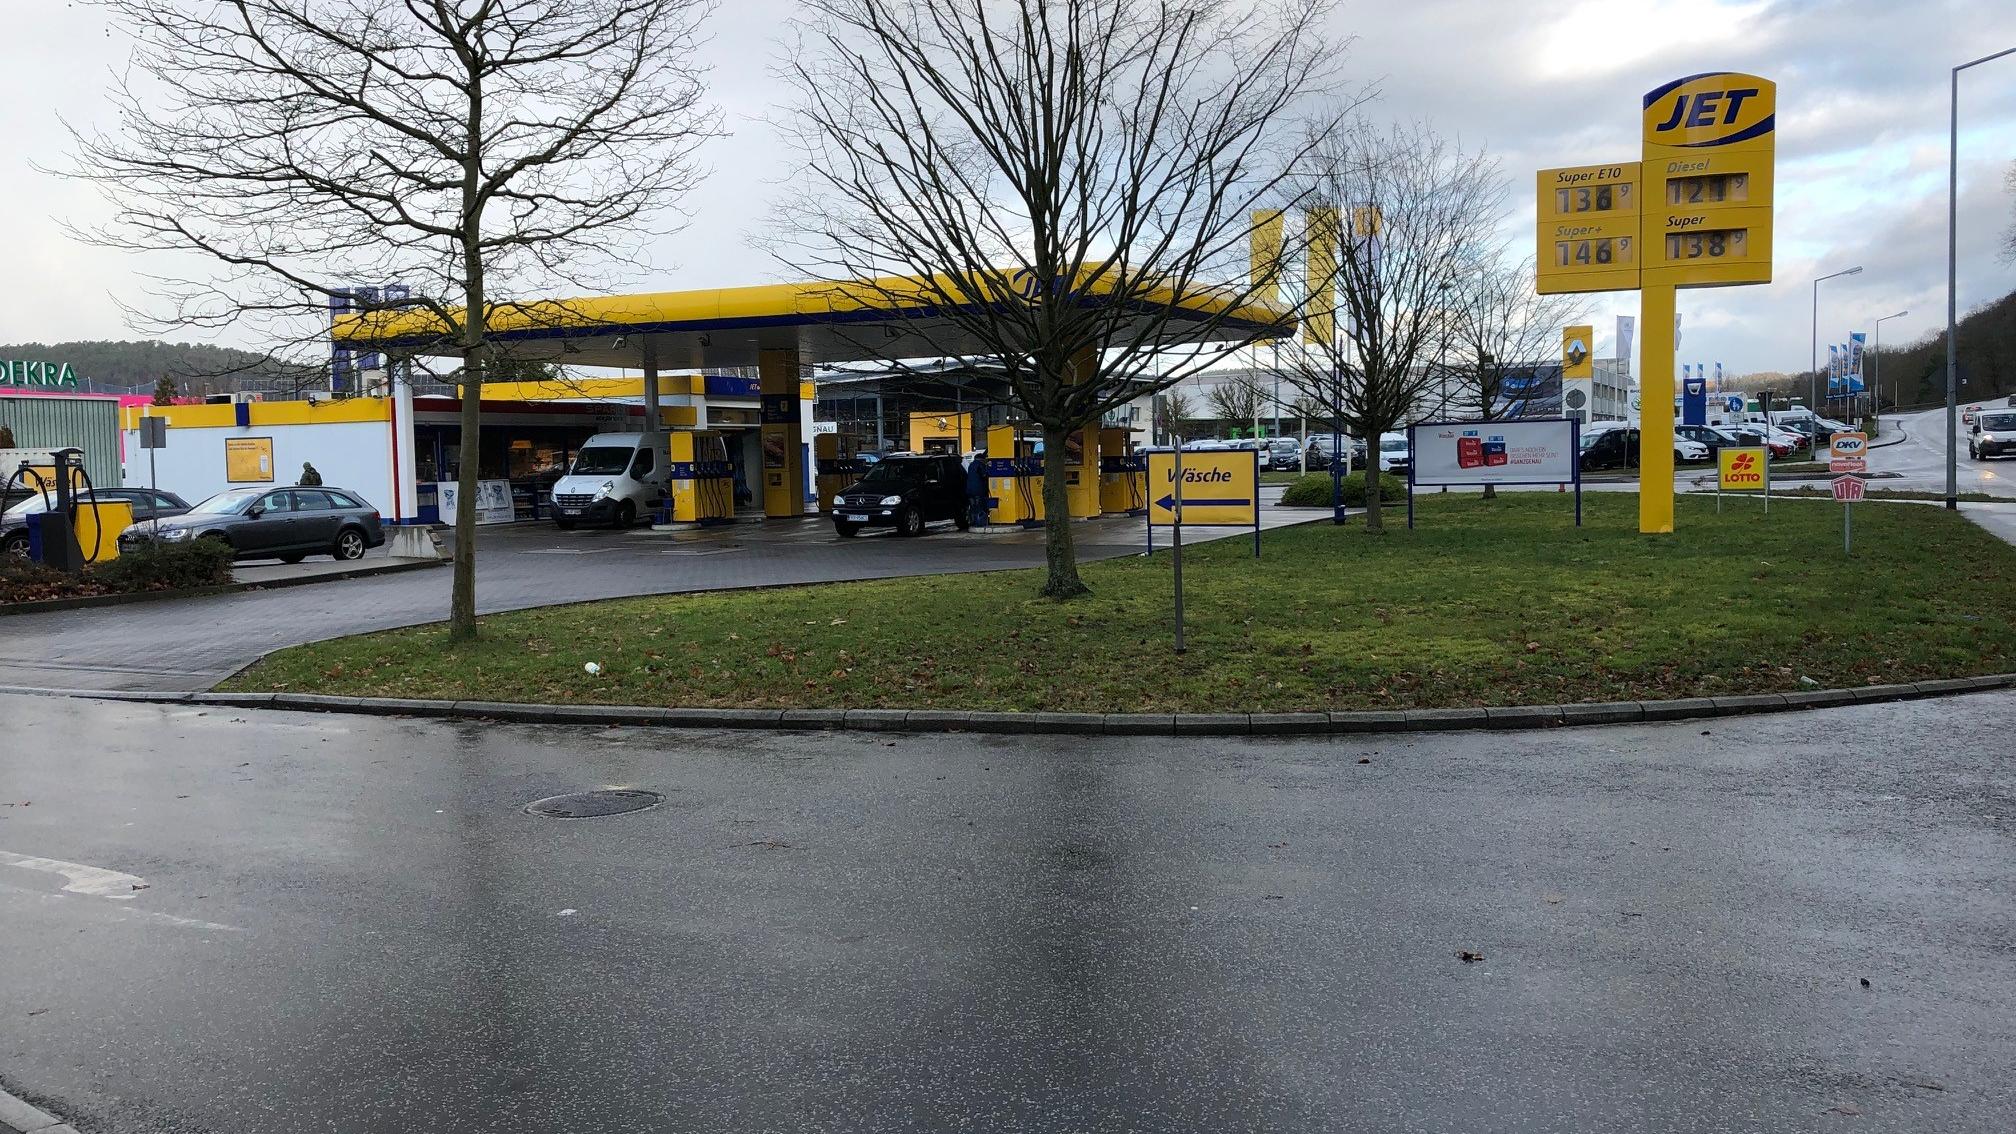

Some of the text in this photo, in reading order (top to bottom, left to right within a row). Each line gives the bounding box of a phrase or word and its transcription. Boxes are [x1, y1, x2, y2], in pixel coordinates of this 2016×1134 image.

[1656, 89, 1758, 132] JET
[1666, 158, 1710, 174] Diesel
[1556, 167, 1622, 185] Super E10
[1556, 186, 1611, 213] 136
[1665, 214, 1706, 228] Super
[1555, 225, 1602, 240] Super+
[1557, 239, 1612, 266] 146
[1667, 233, 1727, 260] 138
[1835, 440, 1862, 449] DKV
[35, 476, 71, 488] Wäse
[1167, 466, 1232, 484] Wäsche
[1724, 473, 1760, 483] LOTTO
